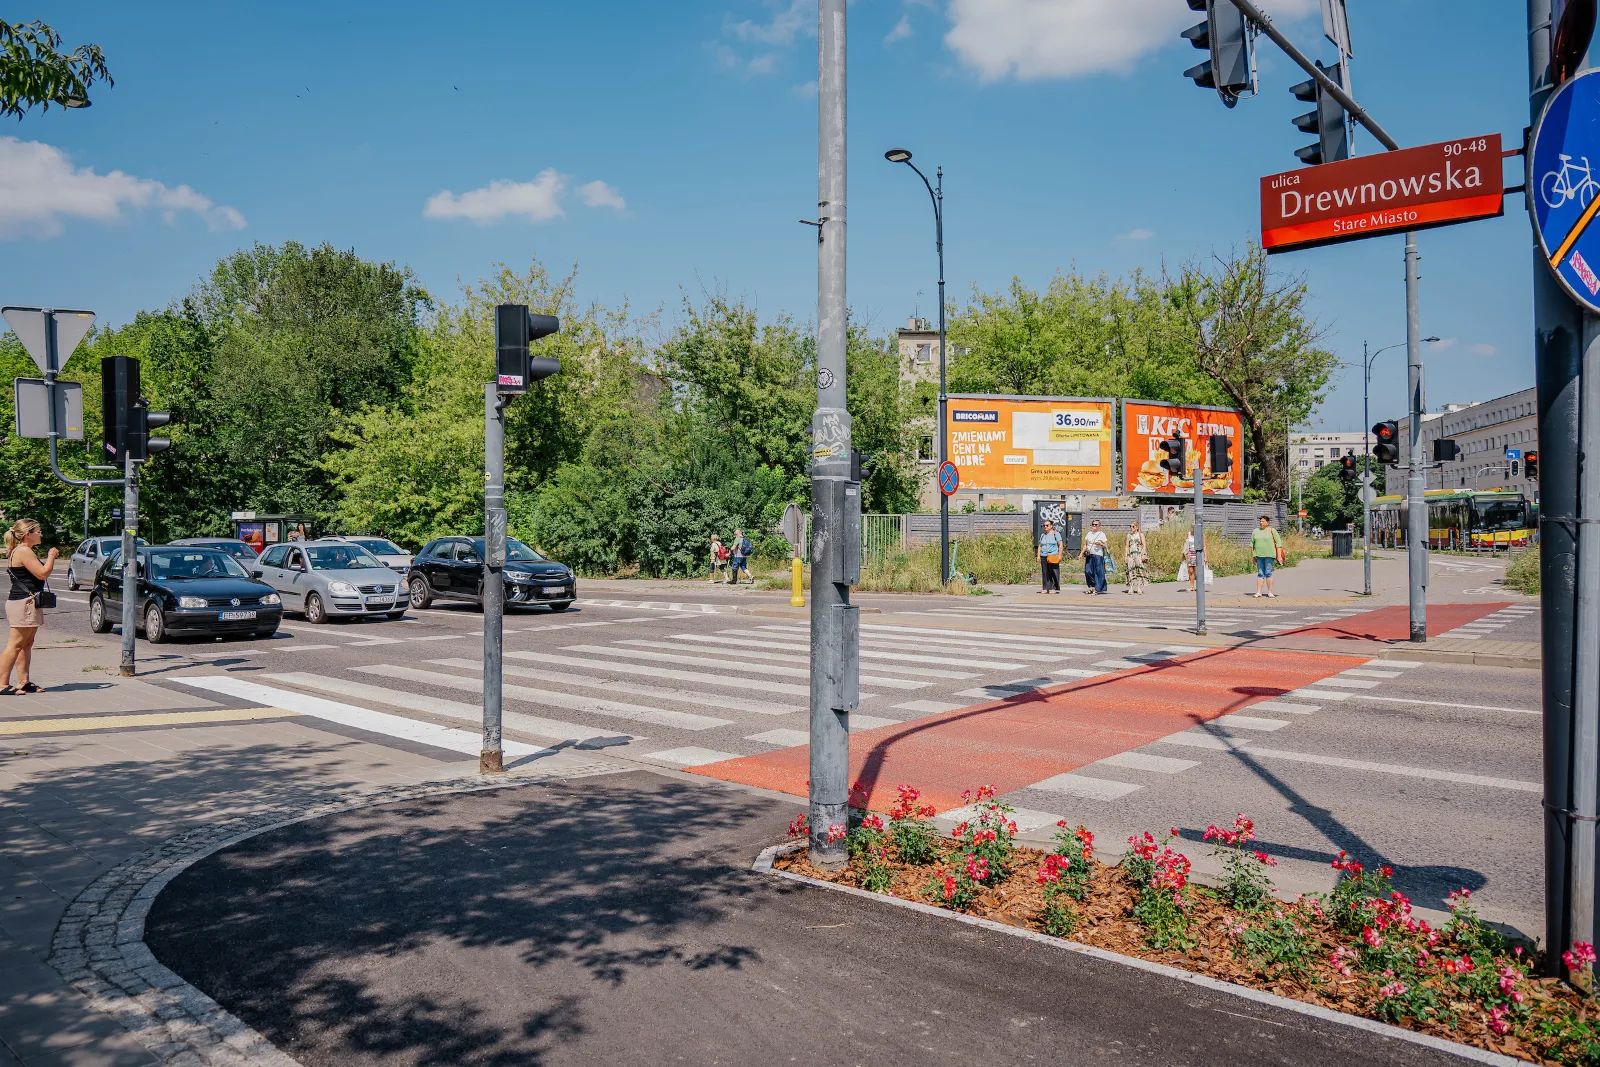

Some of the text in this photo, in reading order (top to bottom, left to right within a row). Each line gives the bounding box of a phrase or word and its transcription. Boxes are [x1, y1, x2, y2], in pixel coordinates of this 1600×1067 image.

[1443, 139, 1487, 157] 90-48
[1271, 174, 1301, 189] ulica
[1280, 160, 1483, 218] Drewnowska
[1332, 210, 1418, 232] Stare Miasto
[955, 412, 996, 421] BRICOMAN
[1151, 416, 1190, 437] KFC
[952, 430, 1007, 443] ZMIENIAMY
[952, 442, 992, 455] CENY NA
[954, 453, 985, 467] DOBRE
